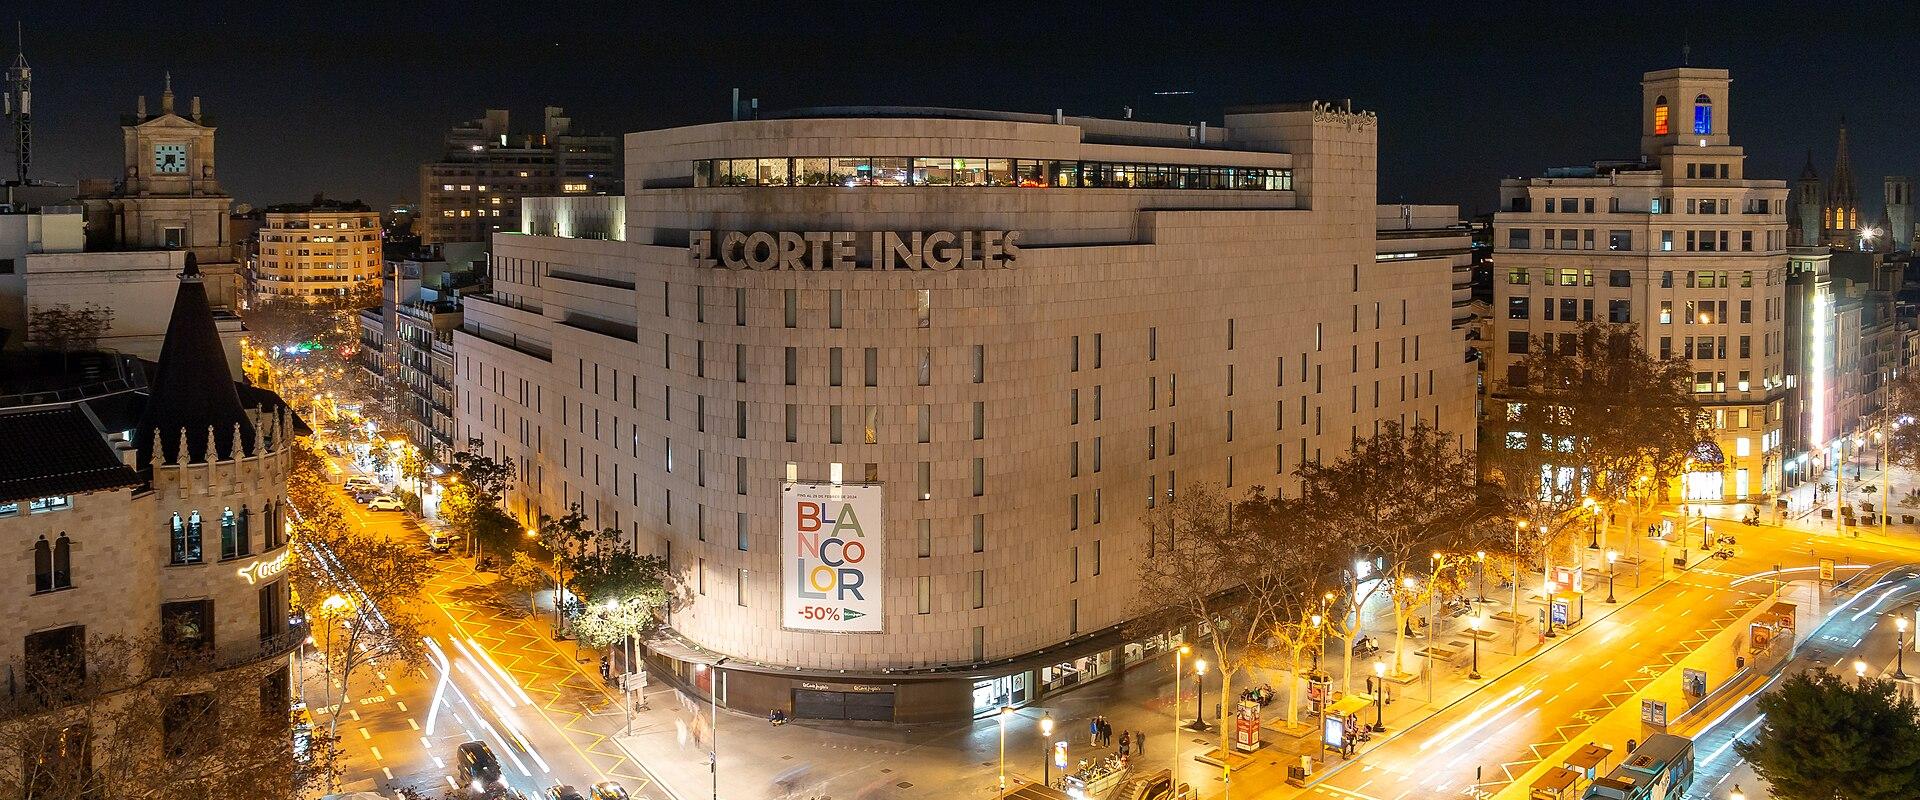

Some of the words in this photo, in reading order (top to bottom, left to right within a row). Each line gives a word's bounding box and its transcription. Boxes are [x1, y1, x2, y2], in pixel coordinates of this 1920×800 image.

[689, 230, 718, 269] EL
[721, 230, 856, 271] CORTE
[872, 230, 1024, 271] INGLES
[798, 606, 840, 622] -50%
[360, 695, 386, 705] BUS
